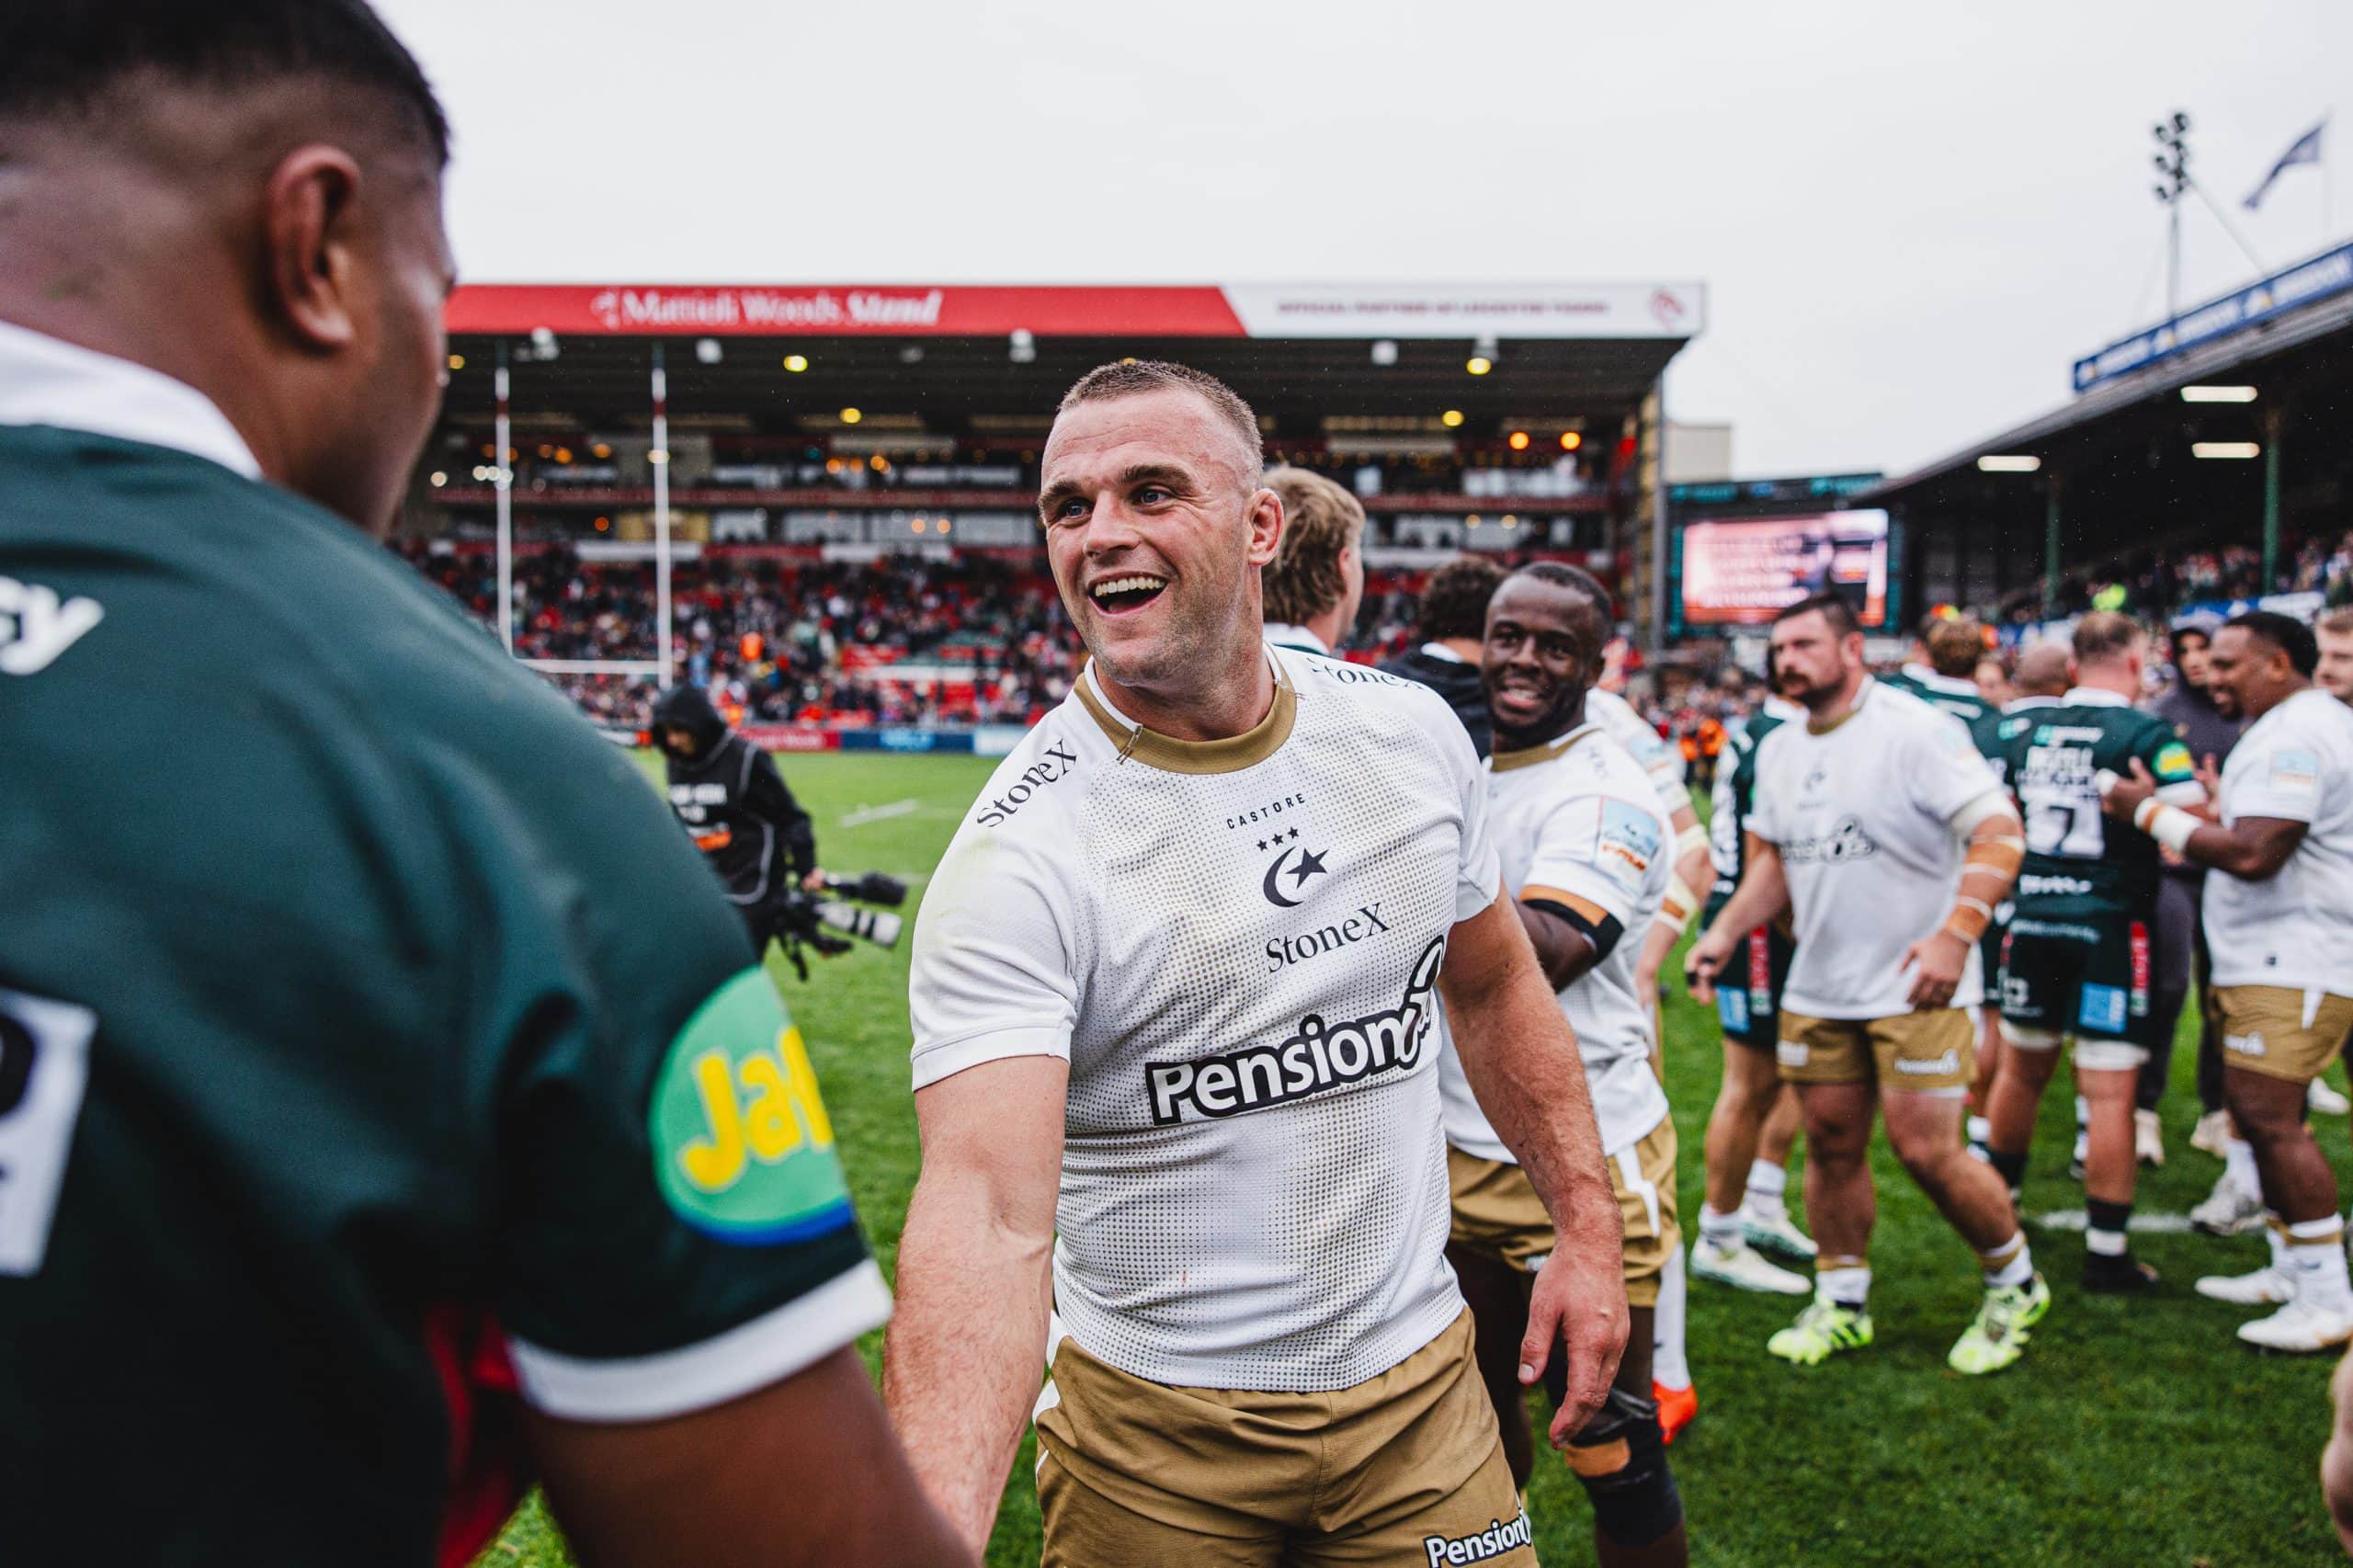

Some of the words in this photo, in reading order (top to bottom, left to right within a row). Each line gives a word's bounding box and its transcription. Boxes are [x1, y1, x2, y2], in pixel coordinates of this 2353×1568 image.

[741, 289, 841, 326] Woods
[976, 736, 1077, 828] StoneX
[1226, 792, 1306, 830] CASTORE
[1265, 901, 1391, 974] StoneX
